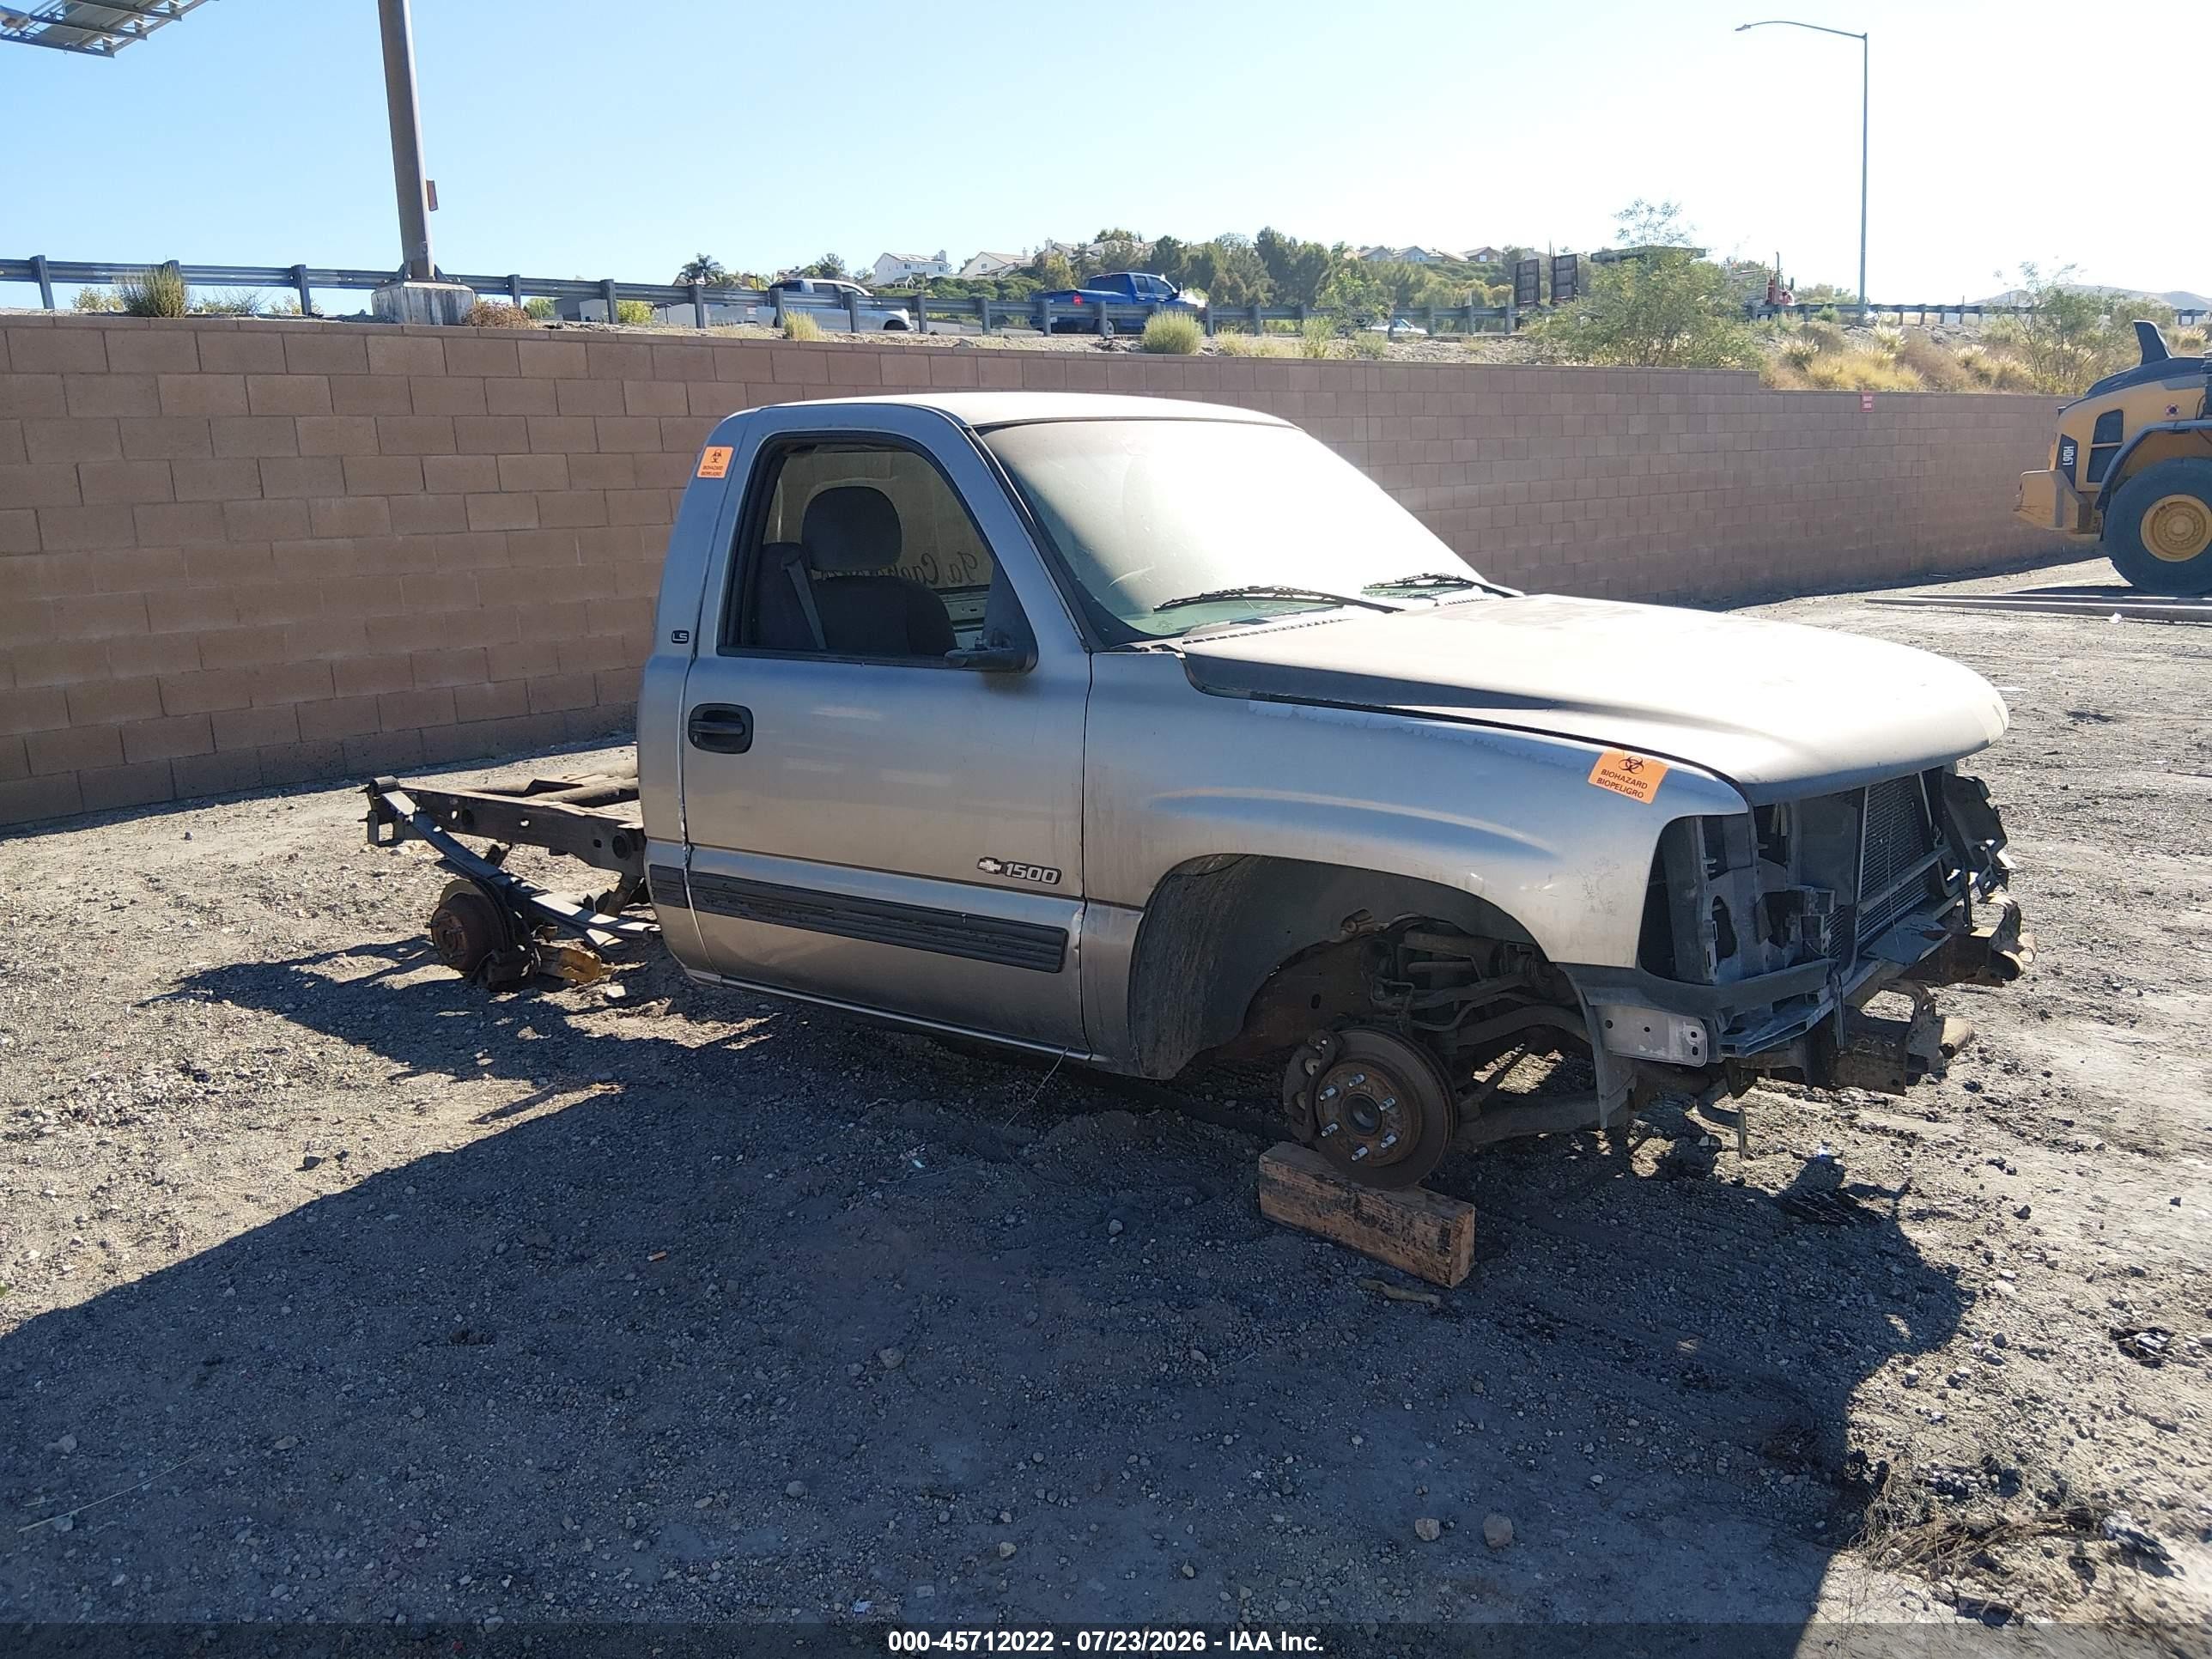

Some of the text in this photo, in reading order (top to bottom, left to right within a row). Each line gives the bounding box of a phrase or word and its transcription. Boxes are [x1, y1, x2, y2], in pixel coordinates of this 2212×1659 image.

[2063, 447, 2074, 465] L90H
[672, 632, 688, 641] LS
[1596, 777, 1644, 799] BIOPELIGRO
[1601, 769, 1648, 789] BIOHAZARD
[1006, 863, 1058, 884] 1500
